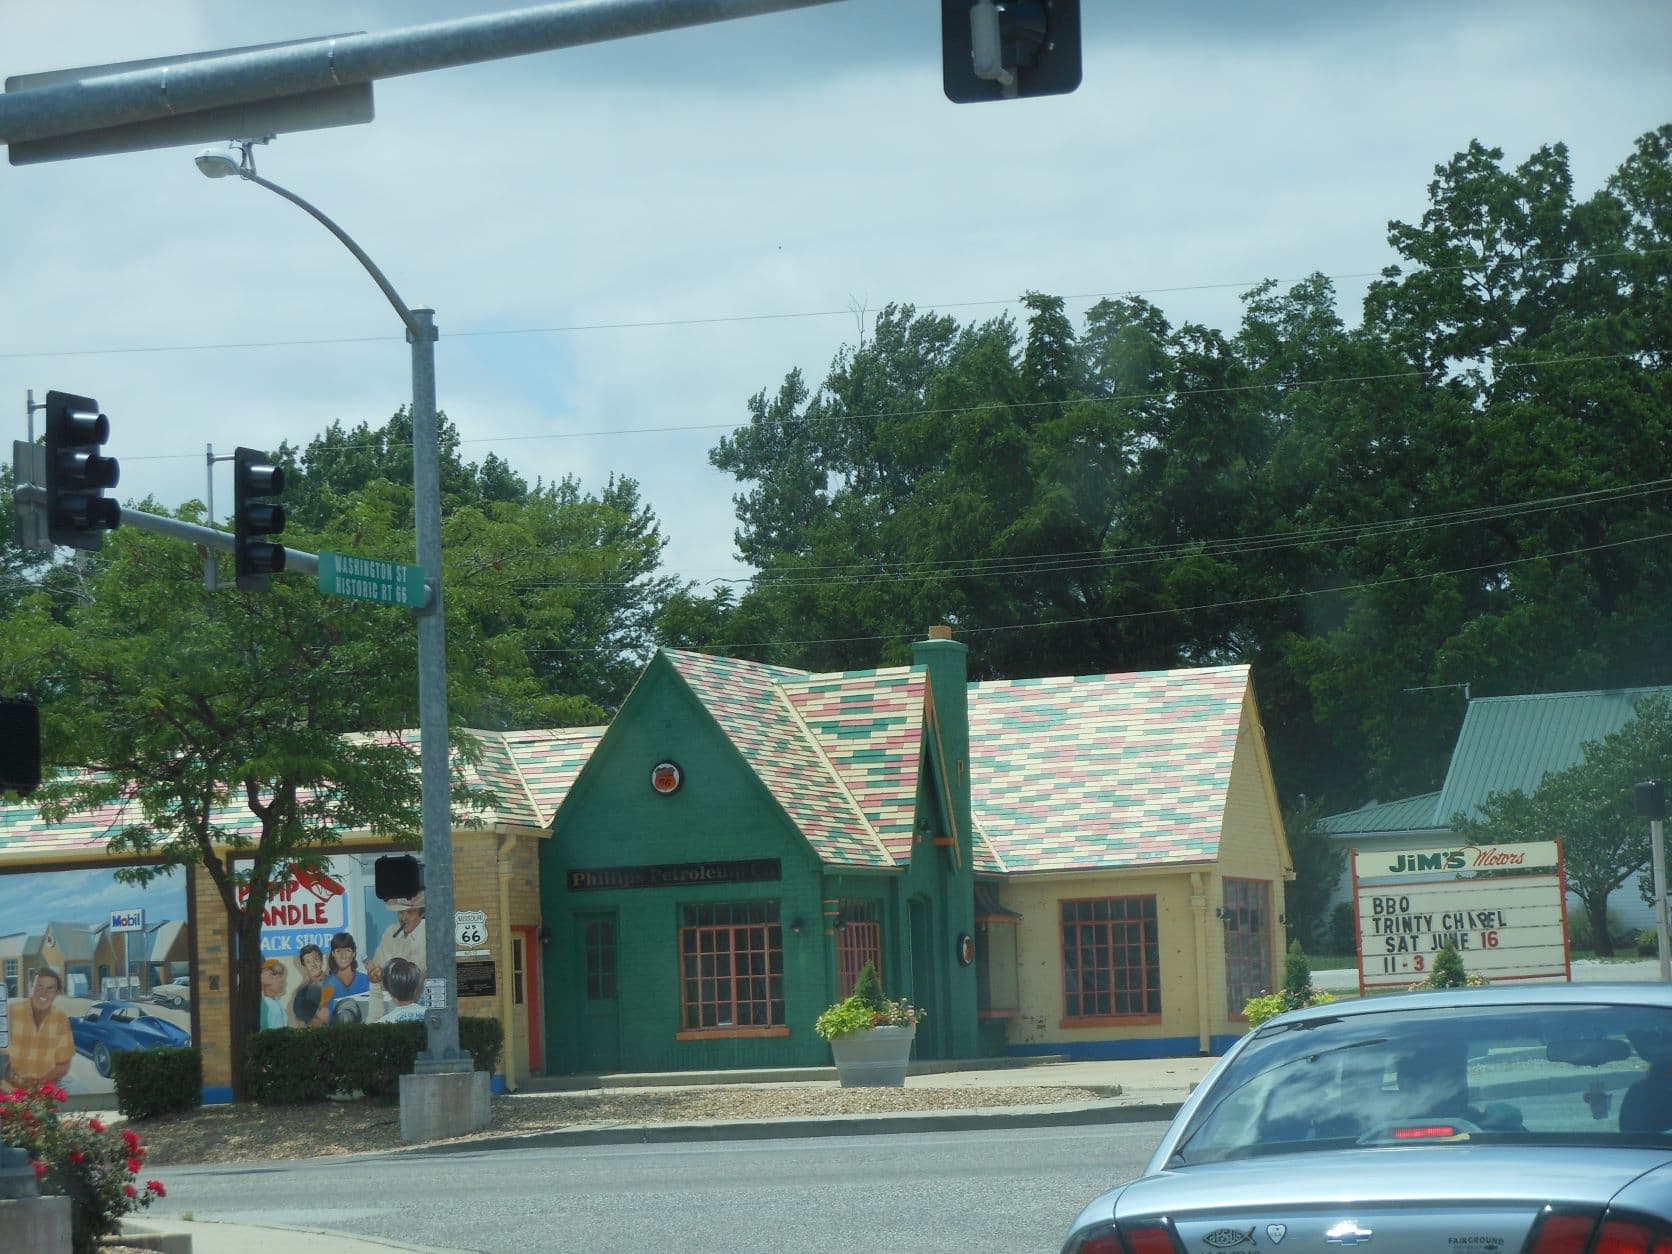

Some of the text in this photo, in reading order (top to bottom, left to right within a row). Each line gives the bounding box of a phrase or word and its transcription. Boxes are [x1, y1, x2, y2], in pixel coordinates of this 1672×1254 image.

[335, 555, 407, 582] WASHINGTON ST
[335, 577, 407, 603] HISTORIC RT 66
[1472, 847, 1525, 867] Motors
[651, 863, 739, 883] Petroleu
[239, 879, 300, 902] PMP
[262, 902, 329, 926] ANDLE
[1373, 896, 1410, 915] BBQ
[112, 913, 140, 927] Mobil
[1372, 911, 1507, 934] TRINTY CHAPEL
[462, 930, 481, 943] 66
[1386, 931, 1499, 953] SAT JUNE 16
[1413, 954, 1425, 972] 3
[1448, 1236, 1504, 1246] FAIRGROUND
